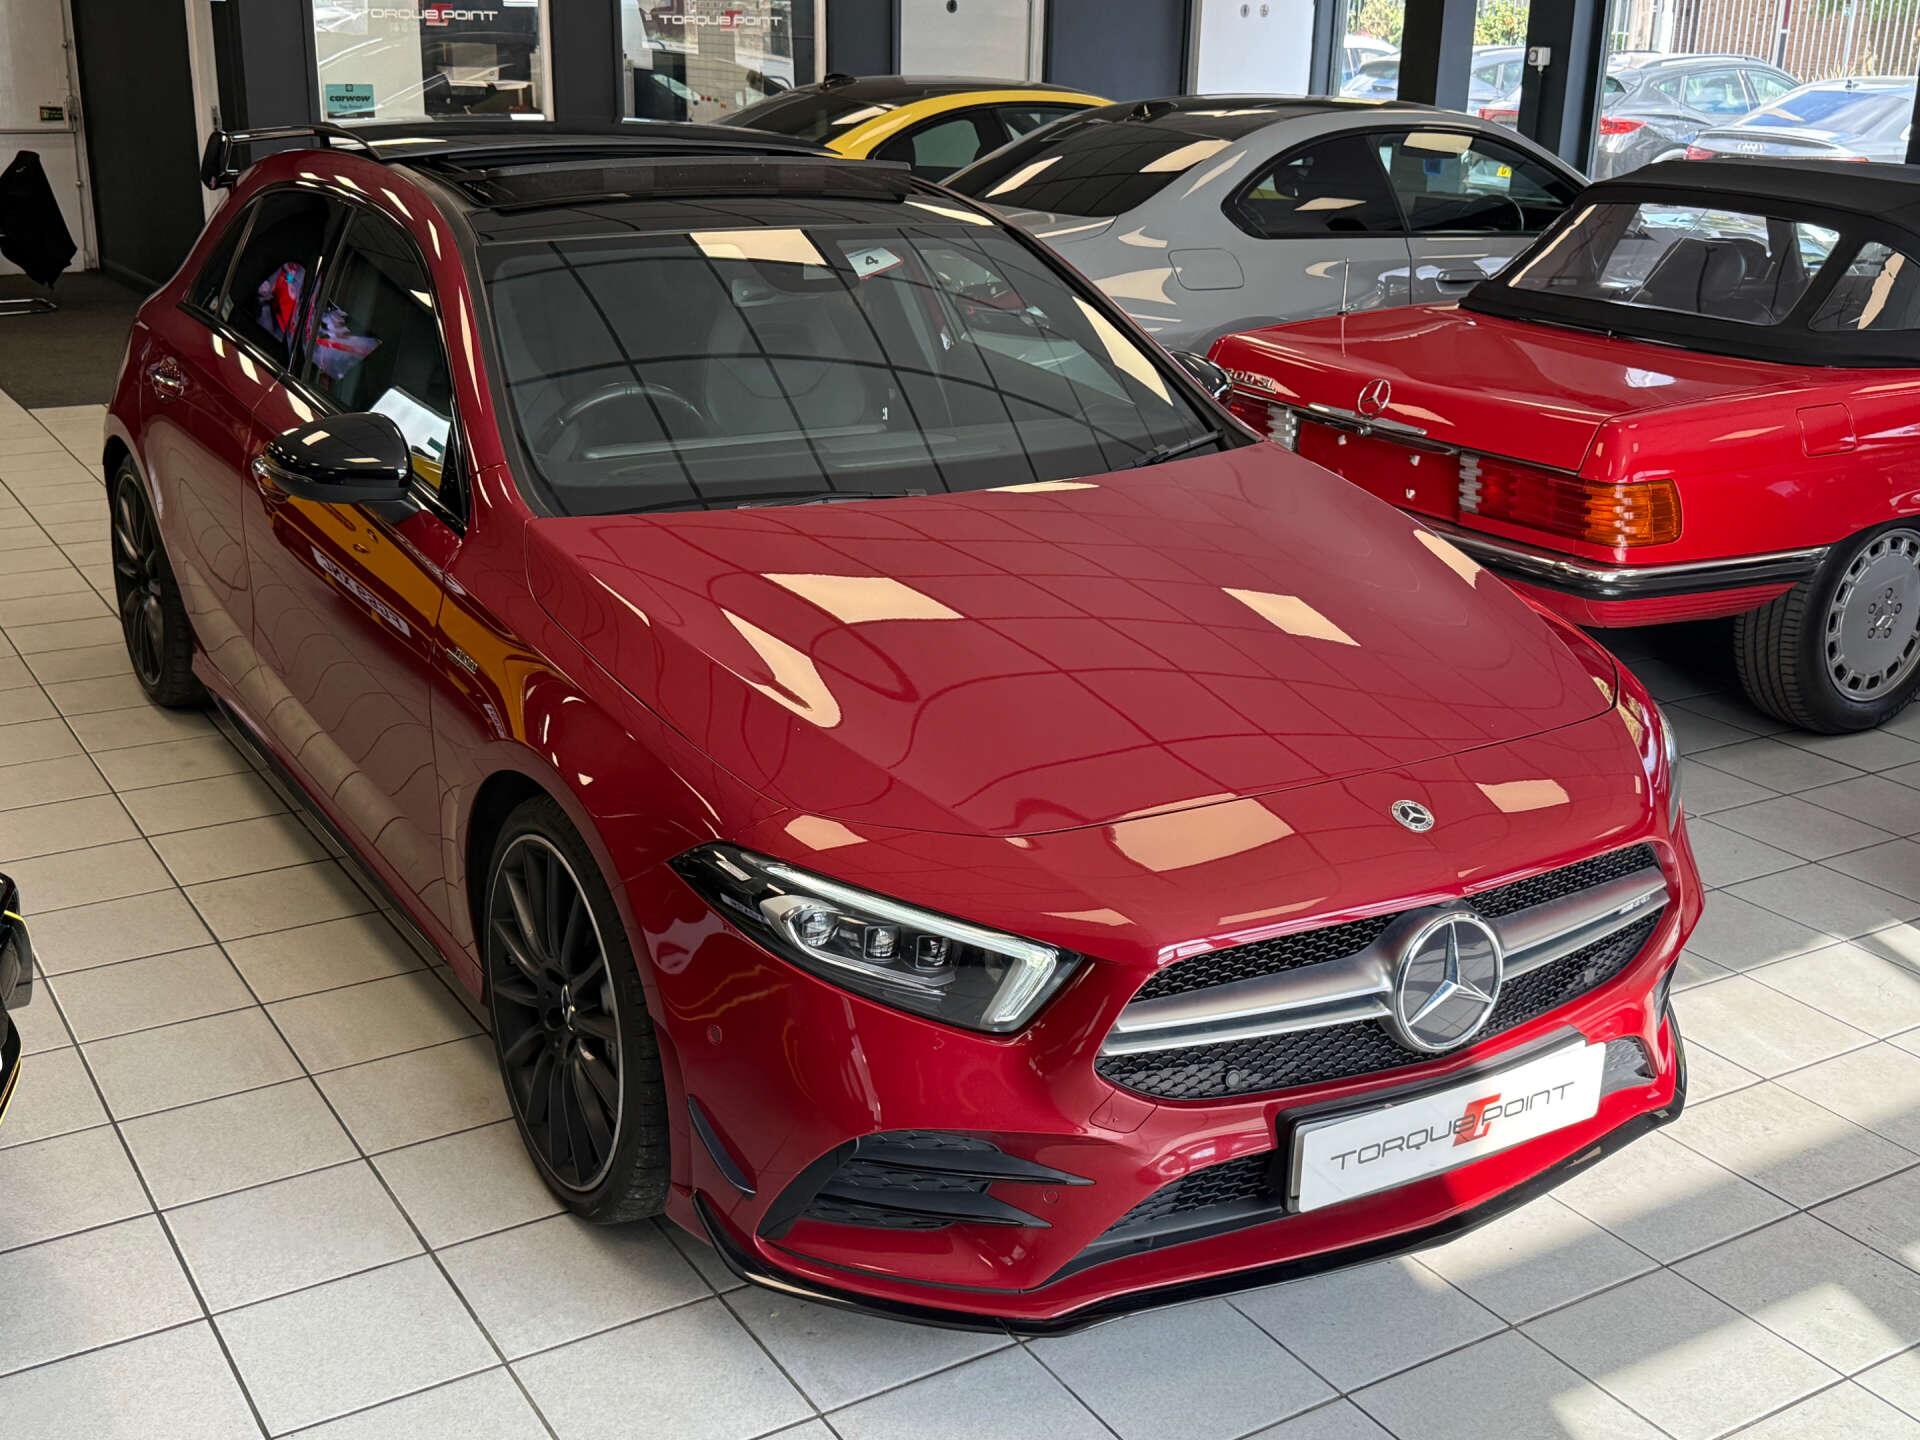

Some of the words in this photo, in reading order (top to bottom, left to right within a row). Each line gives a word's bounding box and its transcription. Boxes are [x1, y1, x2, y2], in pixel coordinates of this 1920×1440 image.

[441, 10, 499, 21] POINT
[658, 15, 731, 27] TORQUE
[732, 15, 783, 26] POINT
[1330, 1115, 1476, 1170] TORQUE
[1480, 1081, 1576, 1126] POINT
